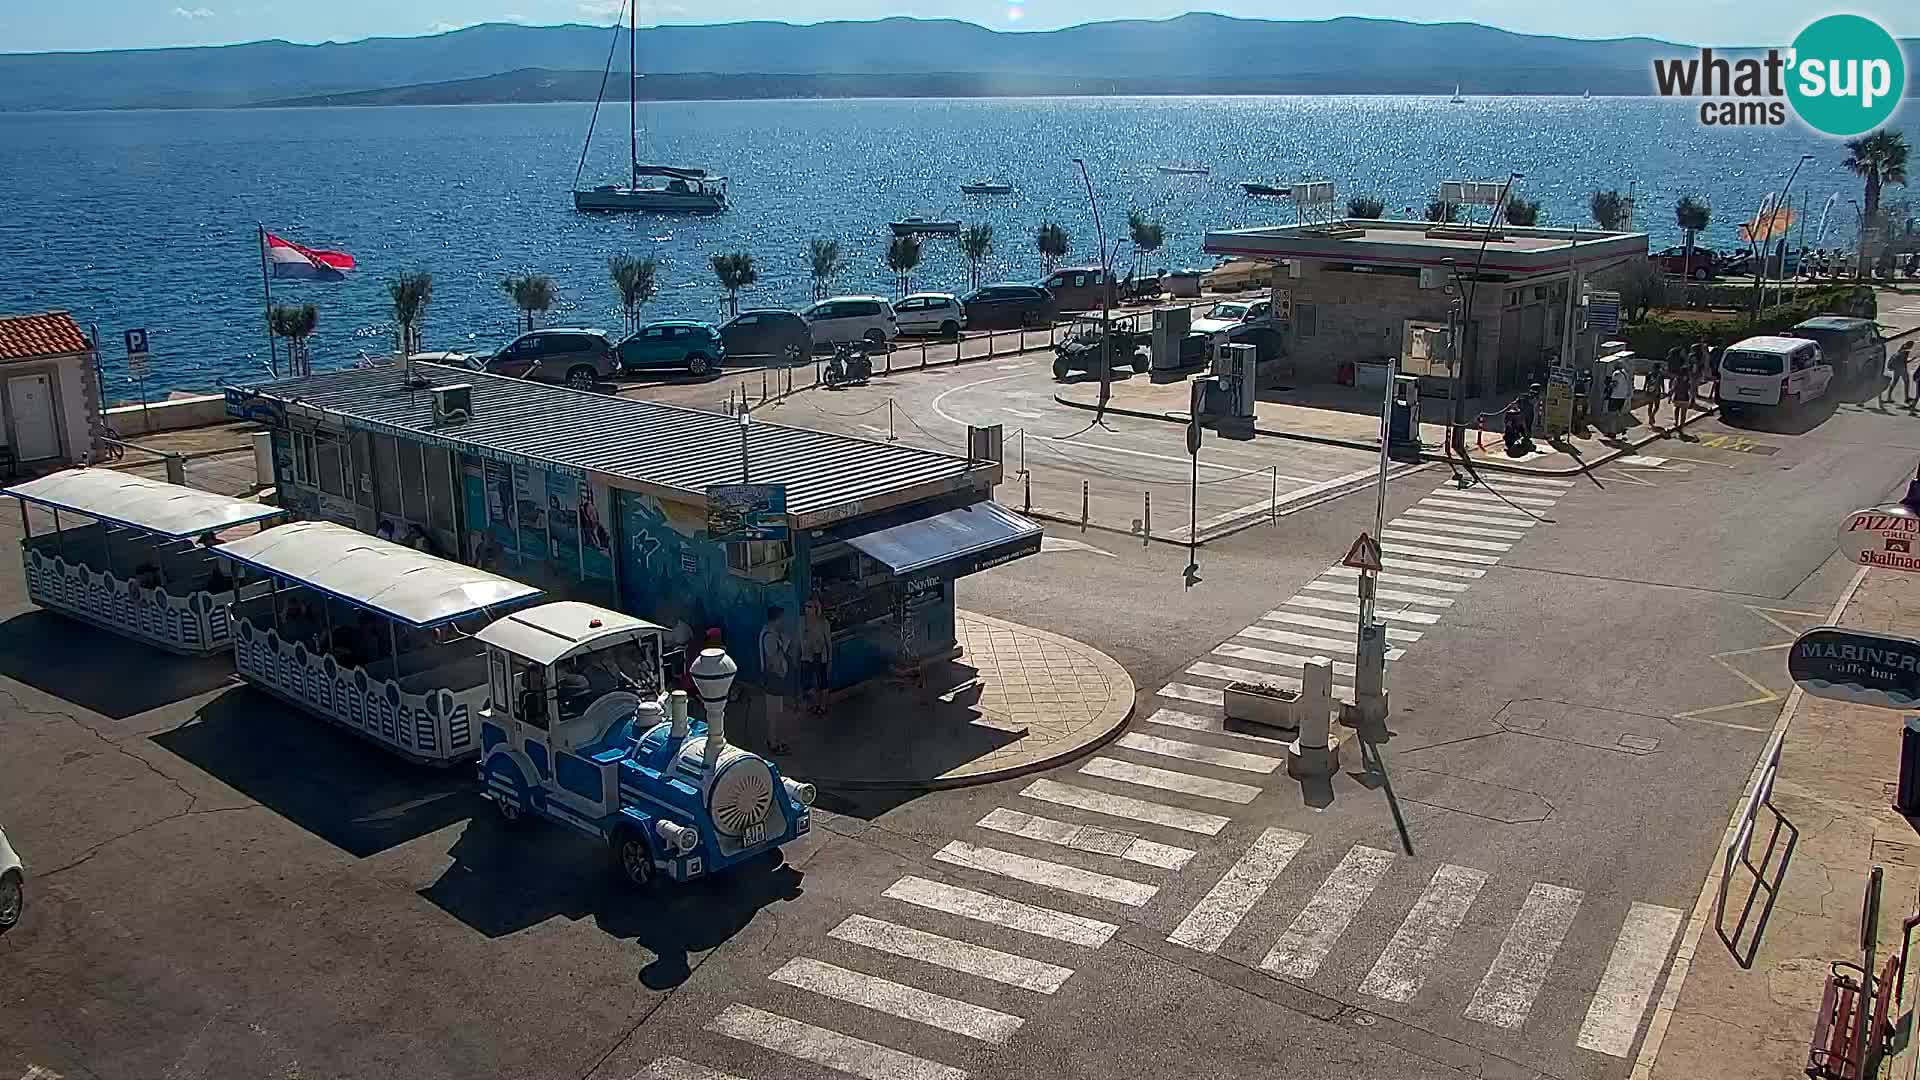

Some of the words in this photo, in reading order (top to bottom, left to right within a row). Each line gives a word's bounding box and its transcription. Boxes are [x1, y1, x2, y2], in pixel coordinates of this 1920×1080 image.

[130, 332, 142, 350] P
[1848, 515, 1920, 533] PIZZE
[1871, 665, 1897, 681] bar
